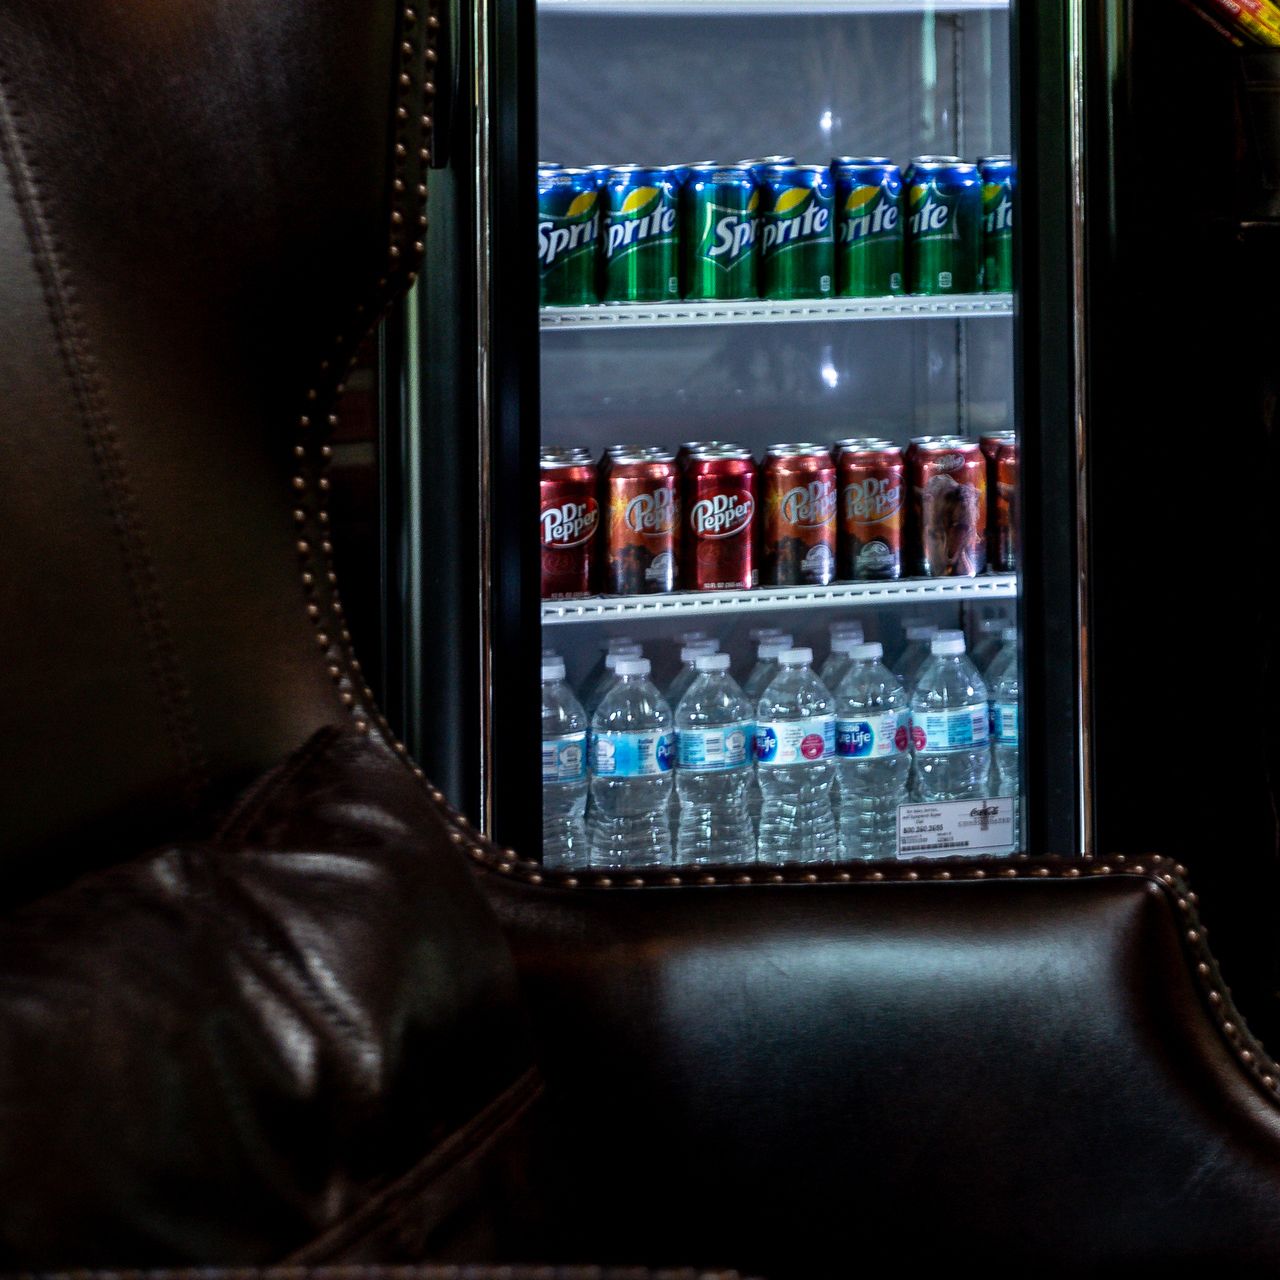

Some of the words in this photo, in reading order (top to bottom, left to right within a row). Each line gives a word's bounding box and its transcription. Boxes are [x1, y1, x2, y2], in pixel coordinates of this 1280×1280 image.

[606, 198, 676, 259] prite
[762, 196, 829, 255] prite
[841, 197, 898, 242] rite
[911, 196, 948, 234] ite
[538, 210, 599, 264] Sprit
[708, 216, 757, 258] Spr
[713, 494, 739, 515] Dr
[808, 480, 831, 499] Dr
[845, 483, 901, 519] Pepper
[863, 477, 889, 496] Dr
[541, 507, 598, 543] Pepper
[562, 502, 587, 523] Dr
[697, 498, 751, 532] Pepper
[851, 729, 872, 744] Life
